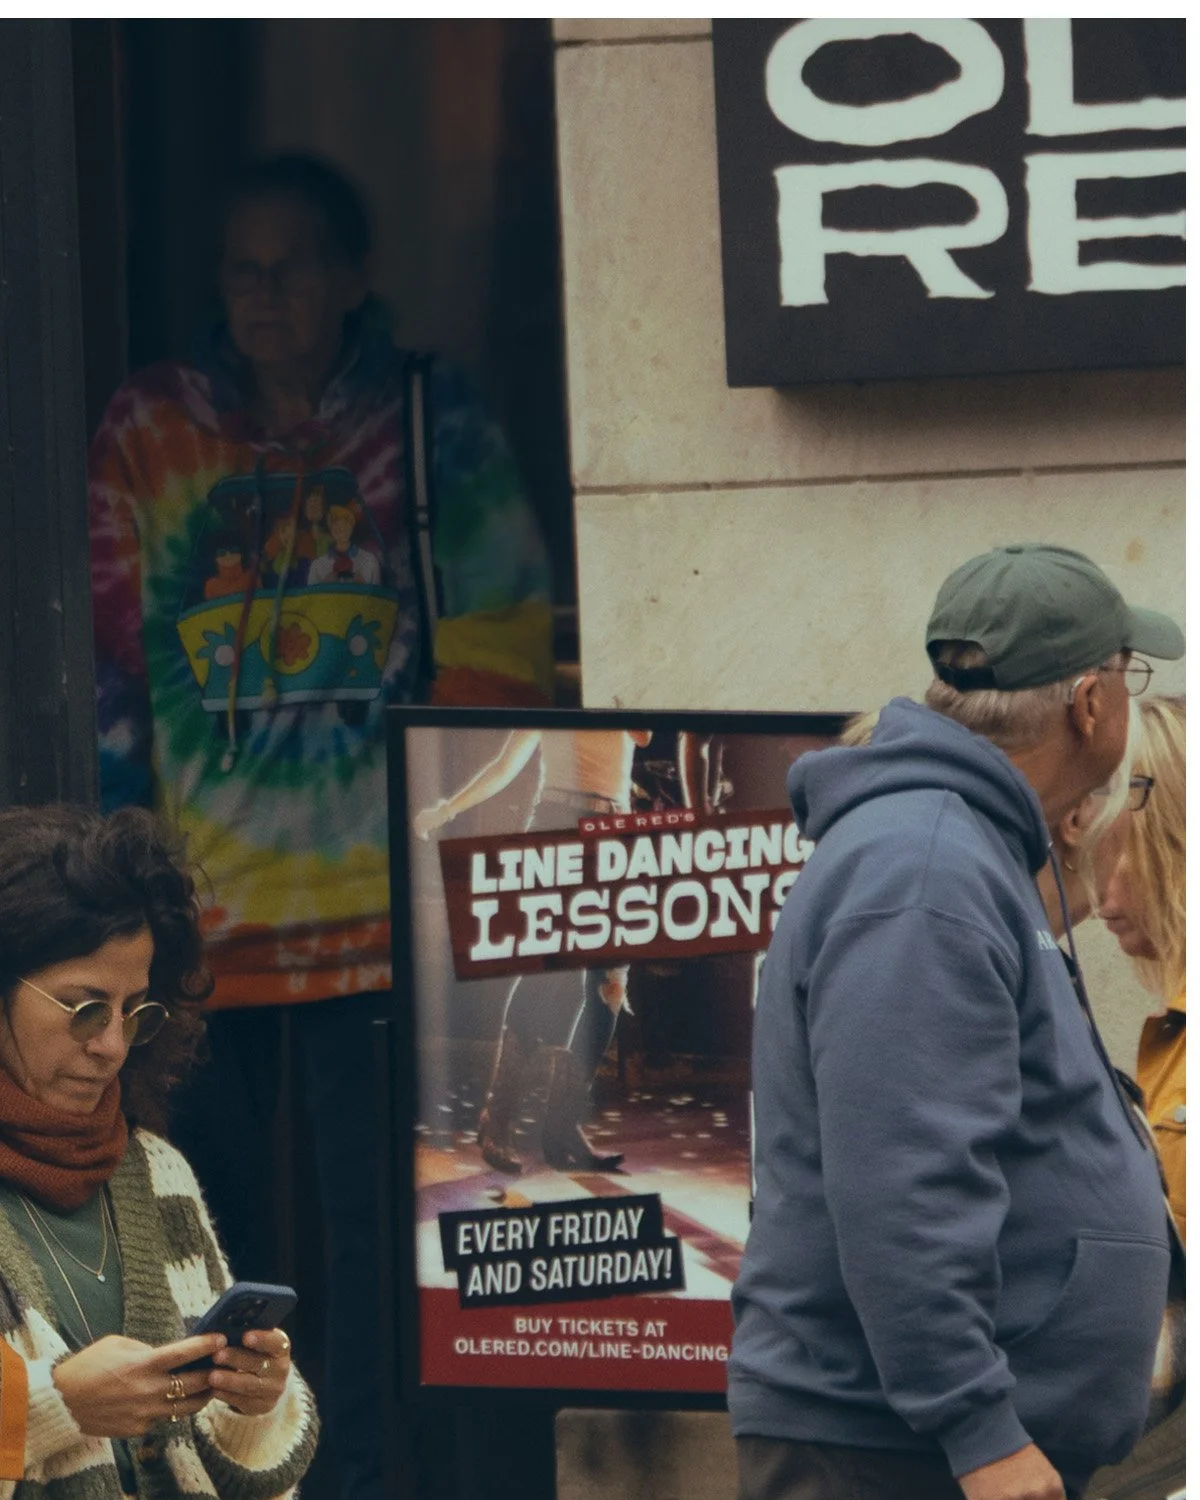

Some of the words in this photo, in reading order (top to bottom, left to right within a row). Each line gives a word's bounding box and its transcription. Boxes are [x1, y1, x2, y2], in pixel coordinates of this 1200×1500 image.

[765, 18, 1186, 146] OL
[774, 148, 1186, 307] RE
[583, 817, 626, 832] OLE
[636, 811, 696, 828] RED'S
[471, 842, 584, 894] LINE
[596, 821, 817, 883] DANCING
[458, 1218, 541, 1255] EVERY
[549, 1207, 645, 1247] FRIDAY
[467, 1263, 522, 1297] AND
[531, 1248, 673, 1291] SATURDAY!
[455, 1338, 729, 1361] OLERED.COM/LINE-DANCING
[515, 1317, 552, 1334] BUY
[560, 1319, 638, 1336] TICKETS
[645, 1321, 668, 1337] AT
